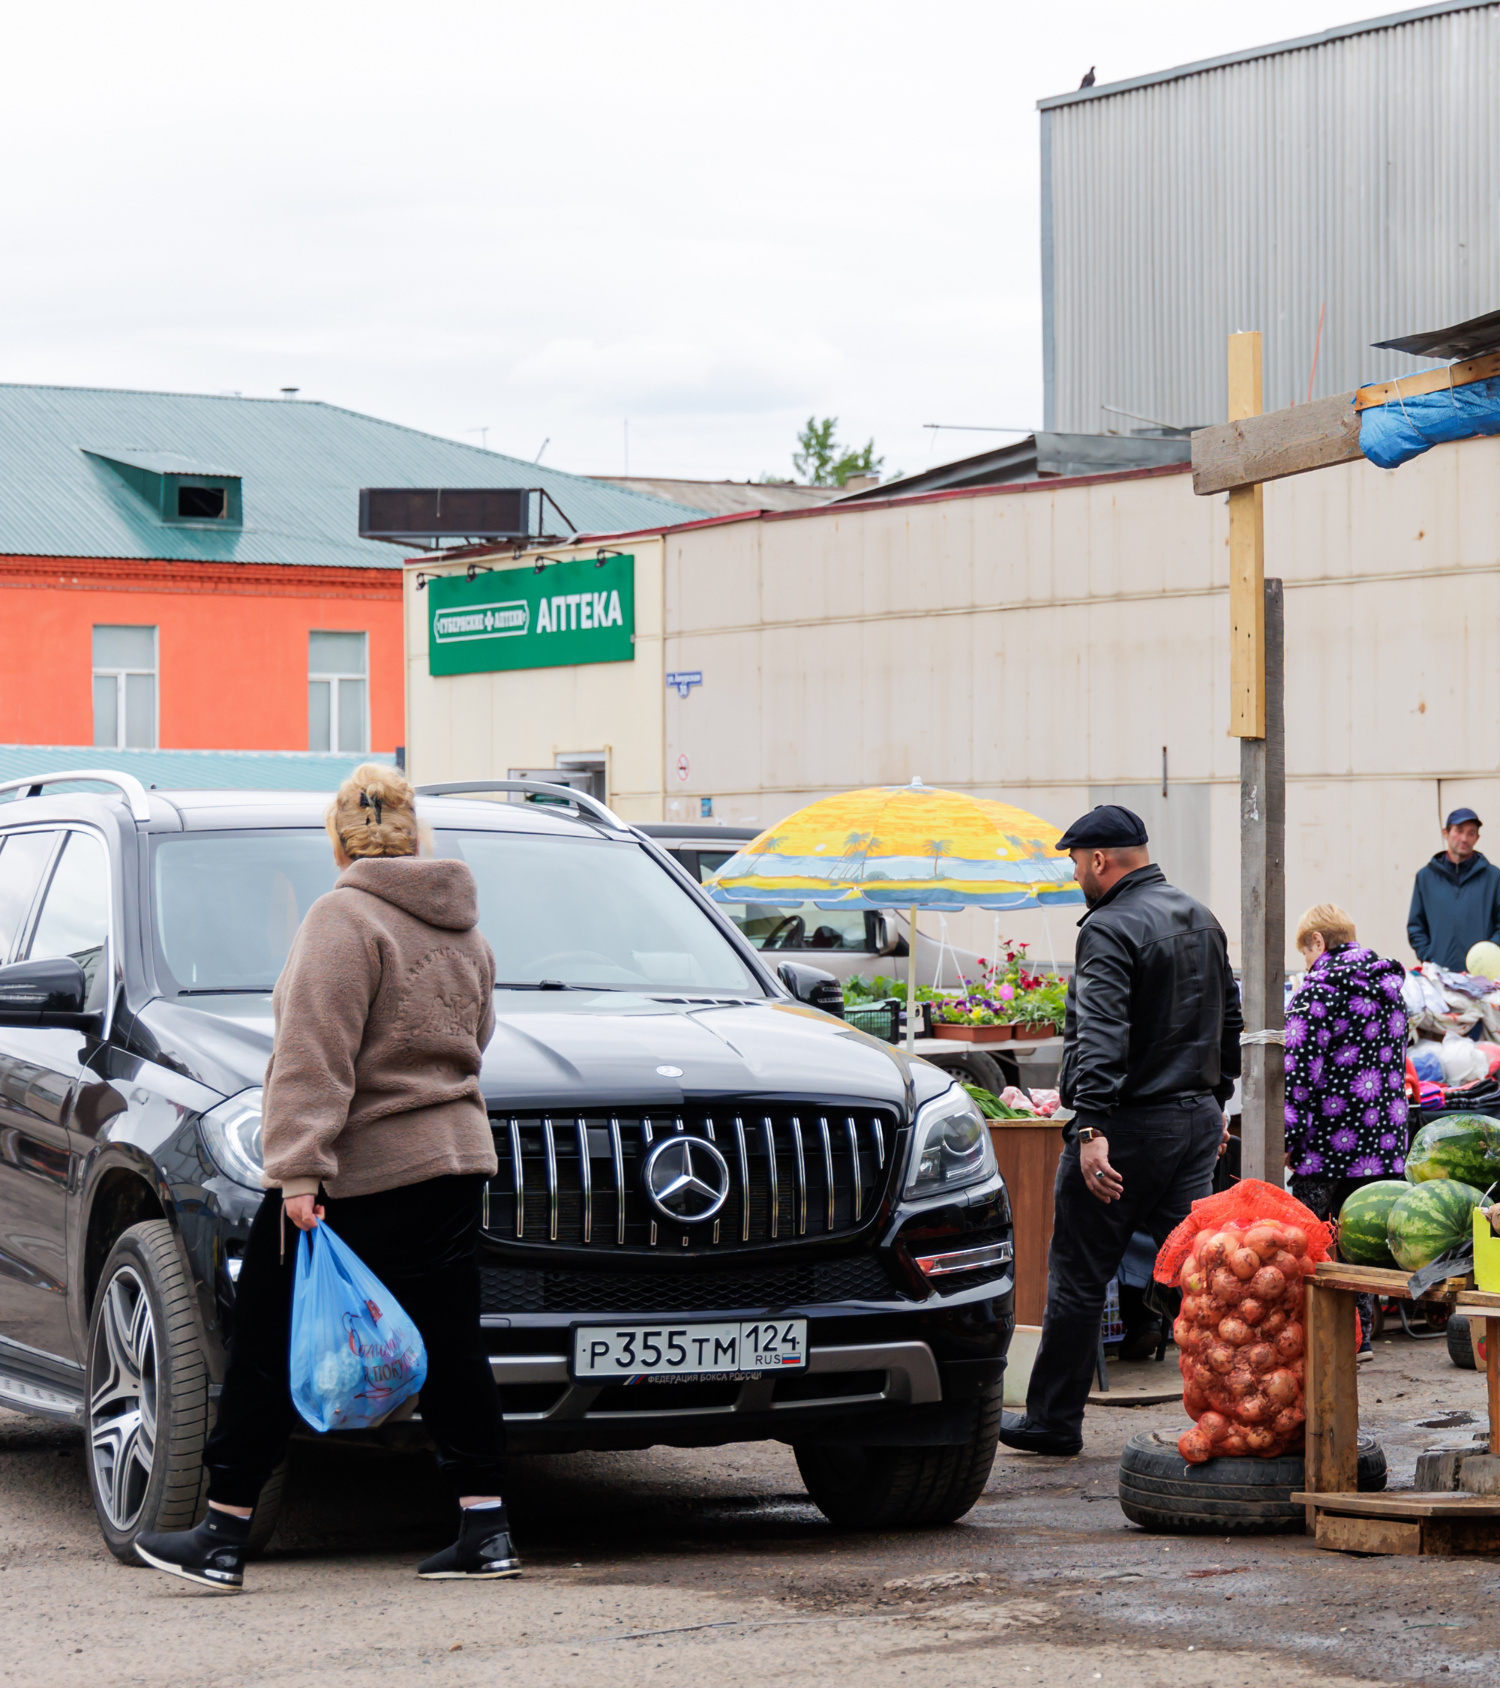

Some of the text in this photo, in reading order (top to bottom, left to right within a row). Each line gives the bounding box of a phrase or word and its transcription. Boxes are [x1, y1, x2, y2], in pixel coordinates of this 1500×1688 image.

[536, 590, 623, 634] АПТЕКА
[745, 1323, 799, 1353] 124
[755, 1354, 781, 1365] RUS
[648, 1370, 762, 1385] ФЕДЕРАЦИЯ БОКСА РОССИИ
